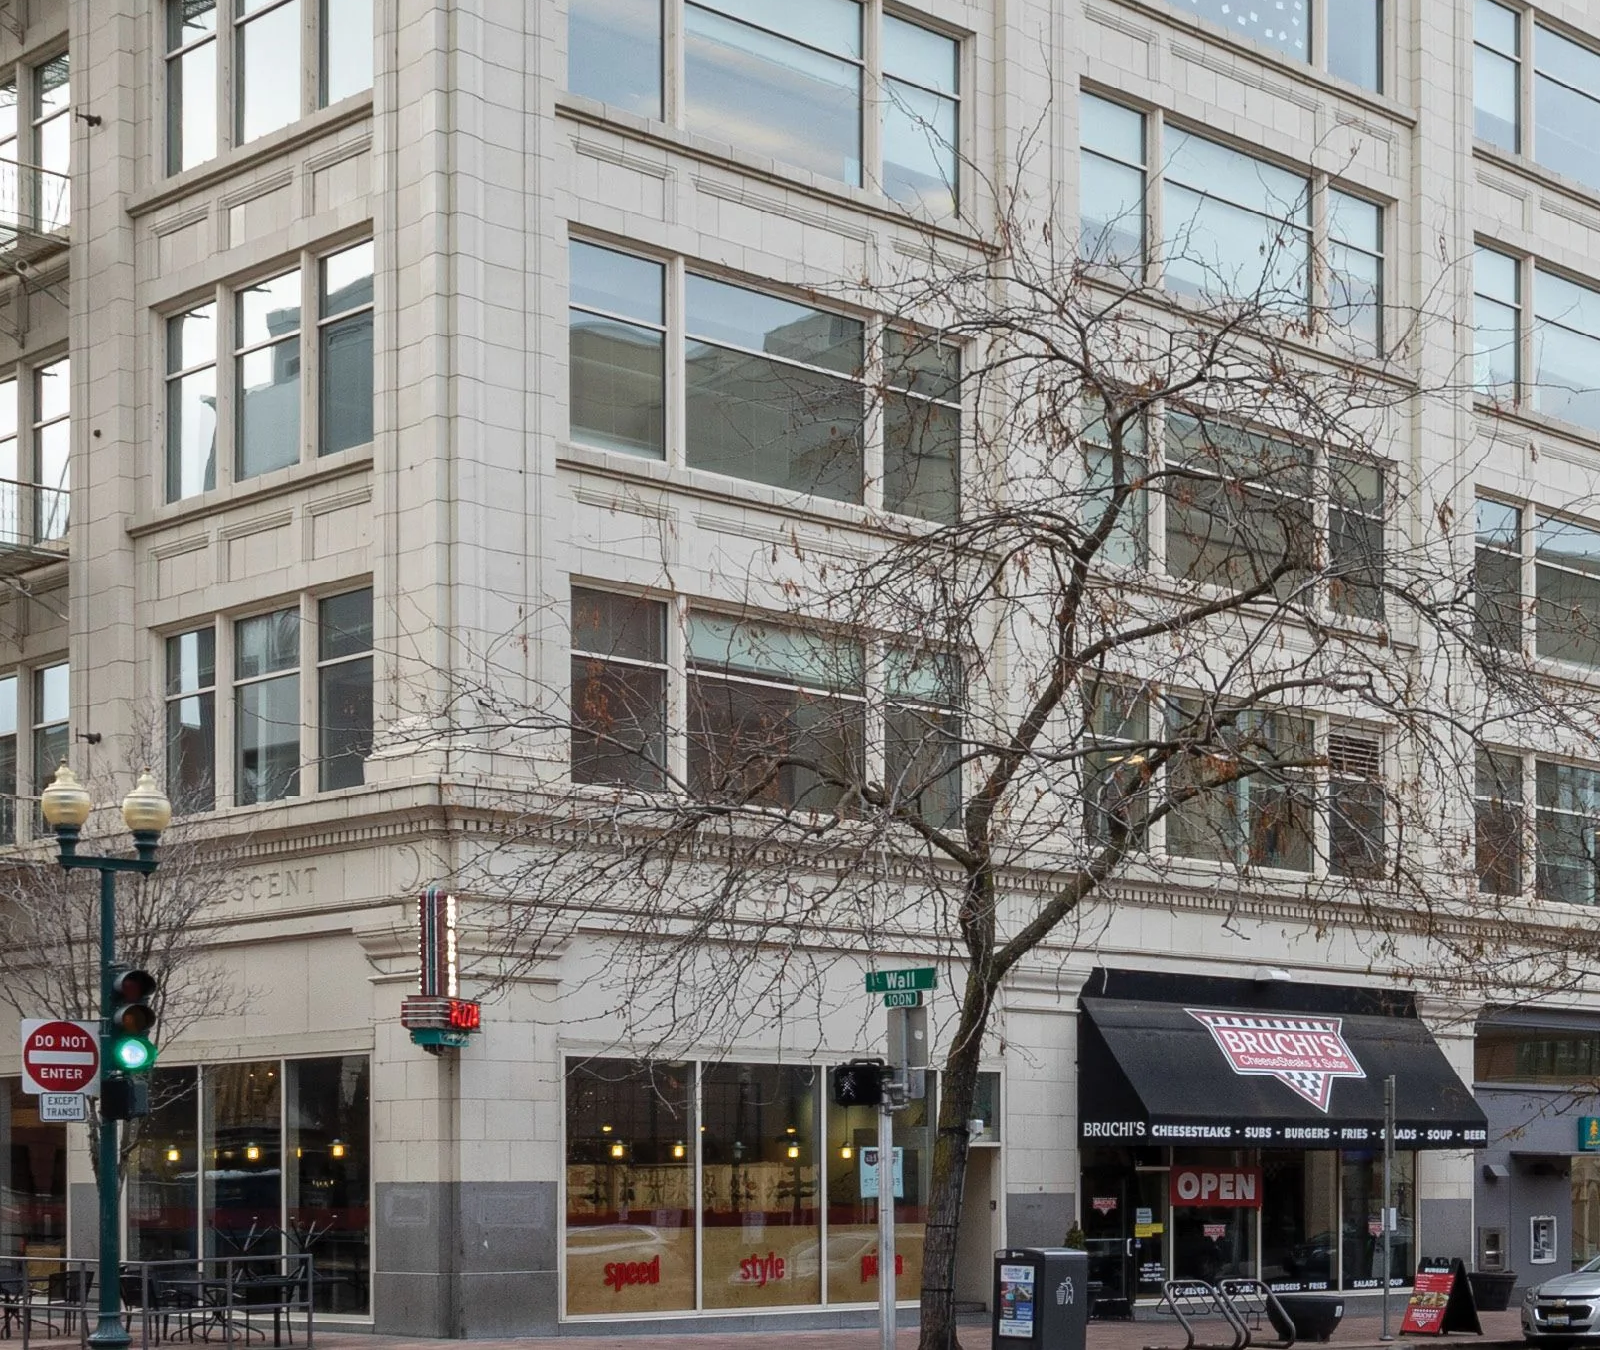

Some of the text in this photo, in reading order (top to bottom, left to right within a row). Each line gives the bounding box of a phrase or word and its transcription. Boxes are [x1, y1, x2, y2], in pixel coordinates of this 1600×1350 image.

[886, 971, 915, 989] Wall
[35, 1035, 87, 1048] DO NOT
[1220, 1029, 1343, 1058] BRUCHI'S
[1239, 1054, 1311, 1067] CheeseSteaks
[1322, 1058, 1349, 1069] Subs
[41, 1068, 83, 1079] ENTER
[48, 1097, 78, 1105] EXCEPT
[47, 1107, 80, 1117] TRANSIT
[1083, 1121, 1146, 1137] BRUCHI'S
[1152, 1125, 1486, 1140] CHEESESTEAKS SUBS BURGERS FRIES SLADS SOUP BEER
[1177, 1171, 1256, 1200] OPEN
[604, 1247, 903, 1292] speed style pia
[1271, 1282, 1300, 1291] BURGERS
[1308, 1281, 1327, 1290] FRIES
[1353, 1279, 1378, 1288] SALADS
